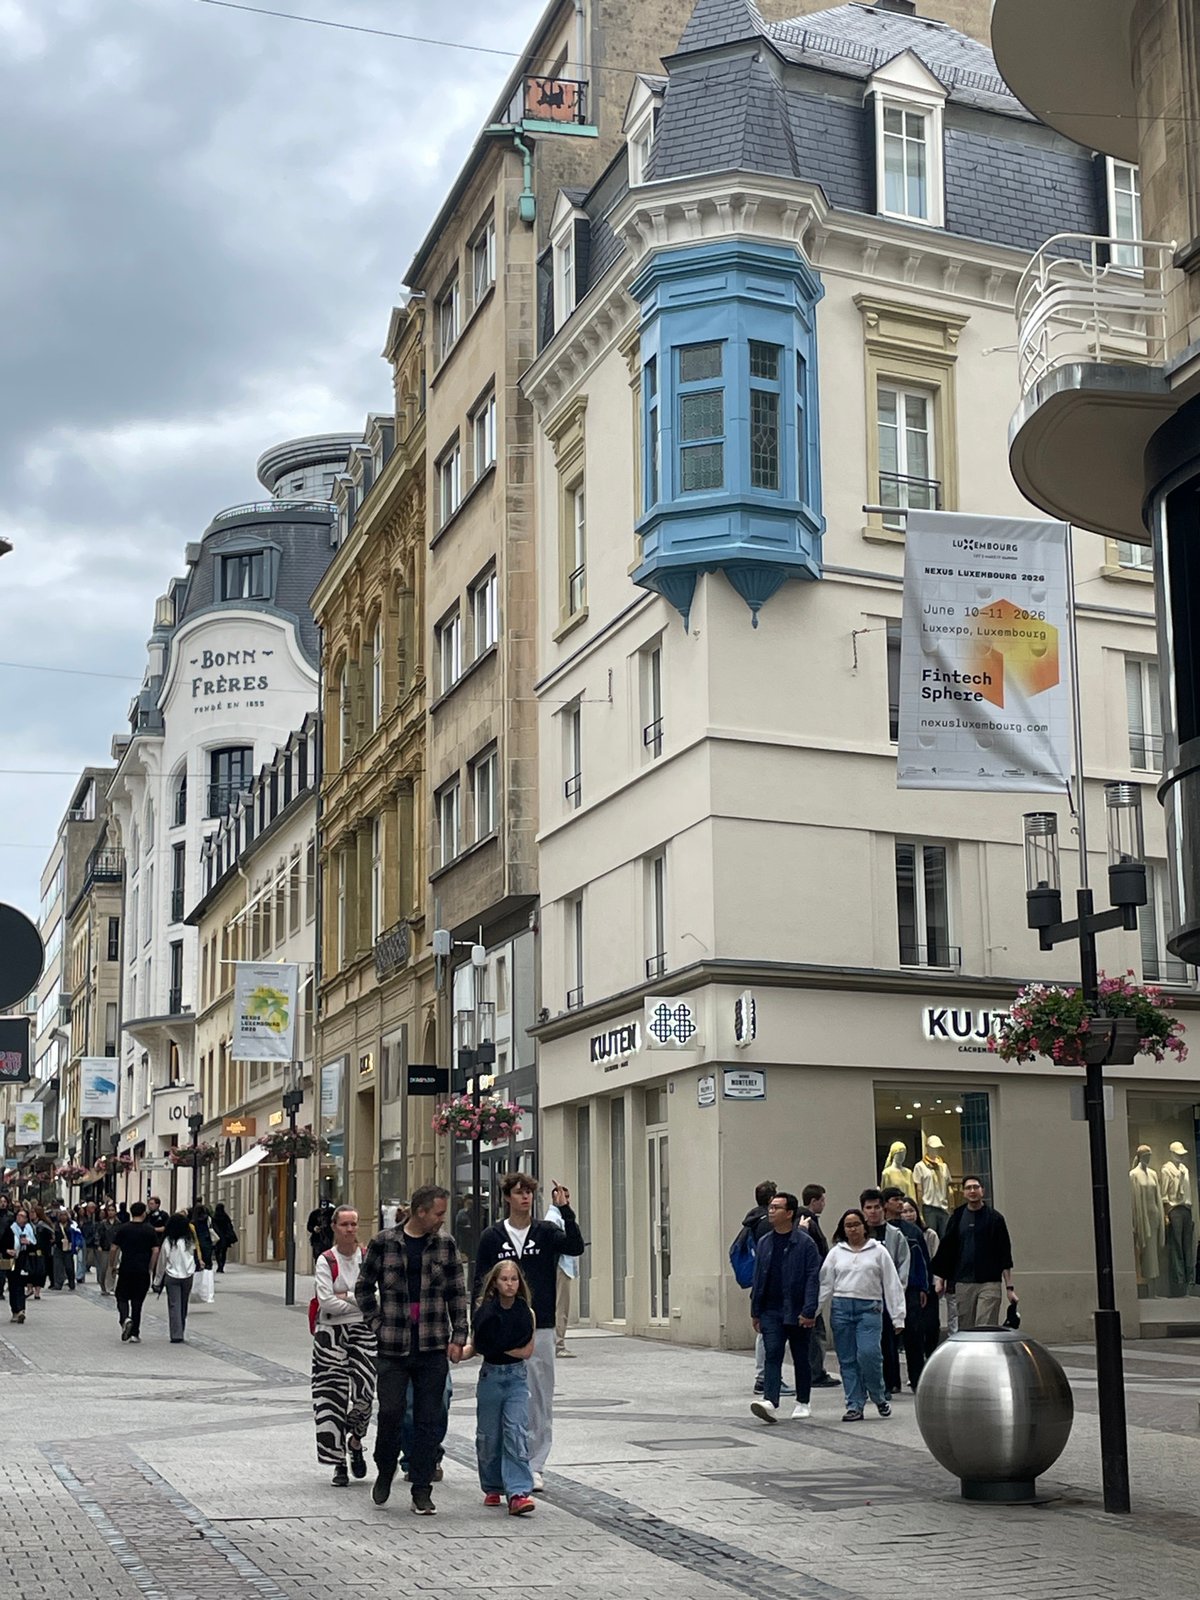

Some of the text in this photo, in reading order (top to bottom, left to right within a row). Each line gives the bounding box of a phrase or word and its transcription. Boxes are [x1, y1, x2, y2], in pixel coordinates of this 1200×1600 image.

[952, 538, 1018, 552] LUXEMBOURG
[924, 567, 1045, 582] NEXUS LUXEMBOURG 2026
[923, 604, 955, 616] June
[1013, 609, 1046, 621] 2026
[922, 623, 1046, 641] Luxexpo, Luxembourg
[201, 649, 257, 669] BONN
[922, 668, 992, 685] Fintech
[191, 674, 269, 698] FRÈRES
[921, 686, 984, 703] Sphere
[921, 718, 1048, 733] nexusluxembourg.com
[927, 1009, 1010, 1039] KUJT
[590, 1023, 637, 1063] KUJTEN
